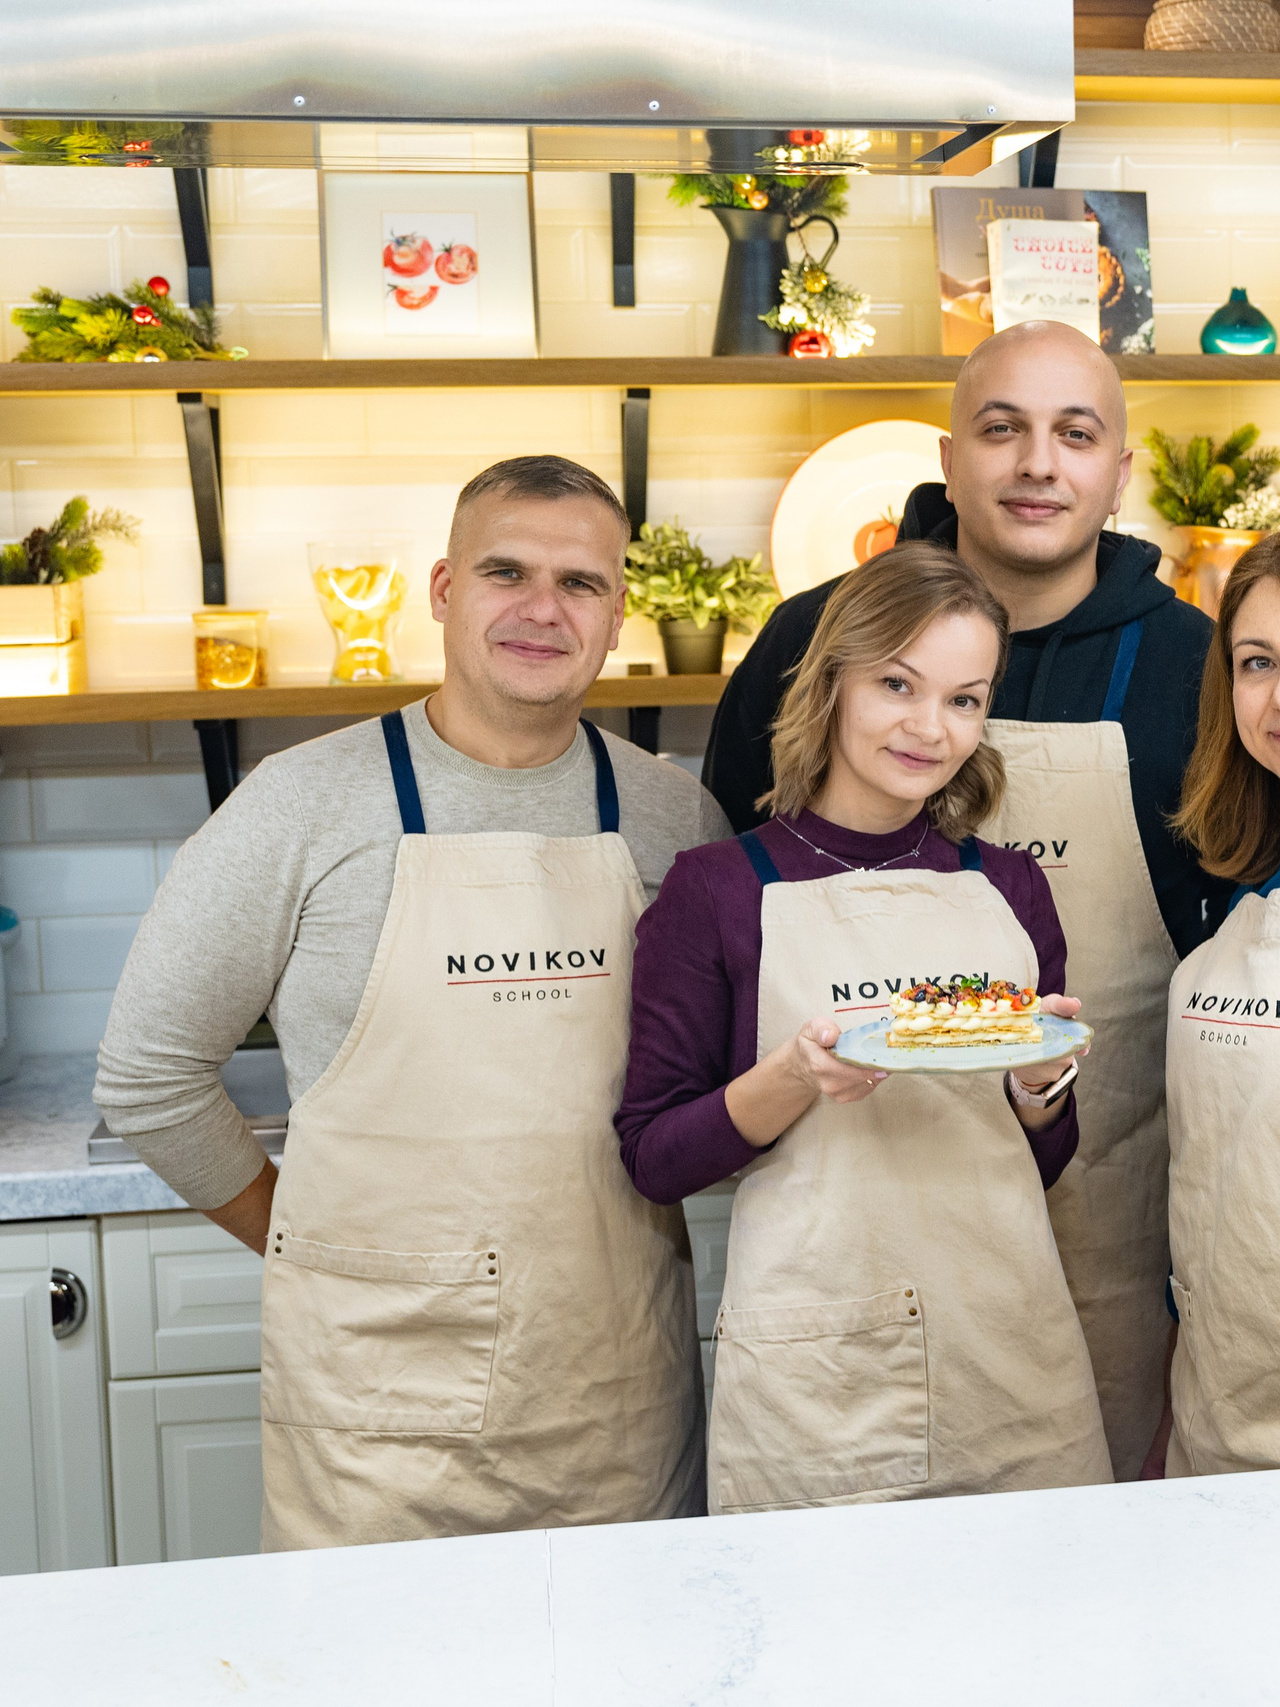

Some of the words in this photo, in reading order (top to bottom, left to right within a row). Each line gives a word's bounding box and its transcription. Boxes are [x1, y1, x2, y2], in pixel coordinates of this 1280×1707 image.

[447, 949, 605, 974] NOVIKOV
[492, 988, 572, 1002] SCHOOL
[1200, 1030, 1247, 1046] SCHOOL
